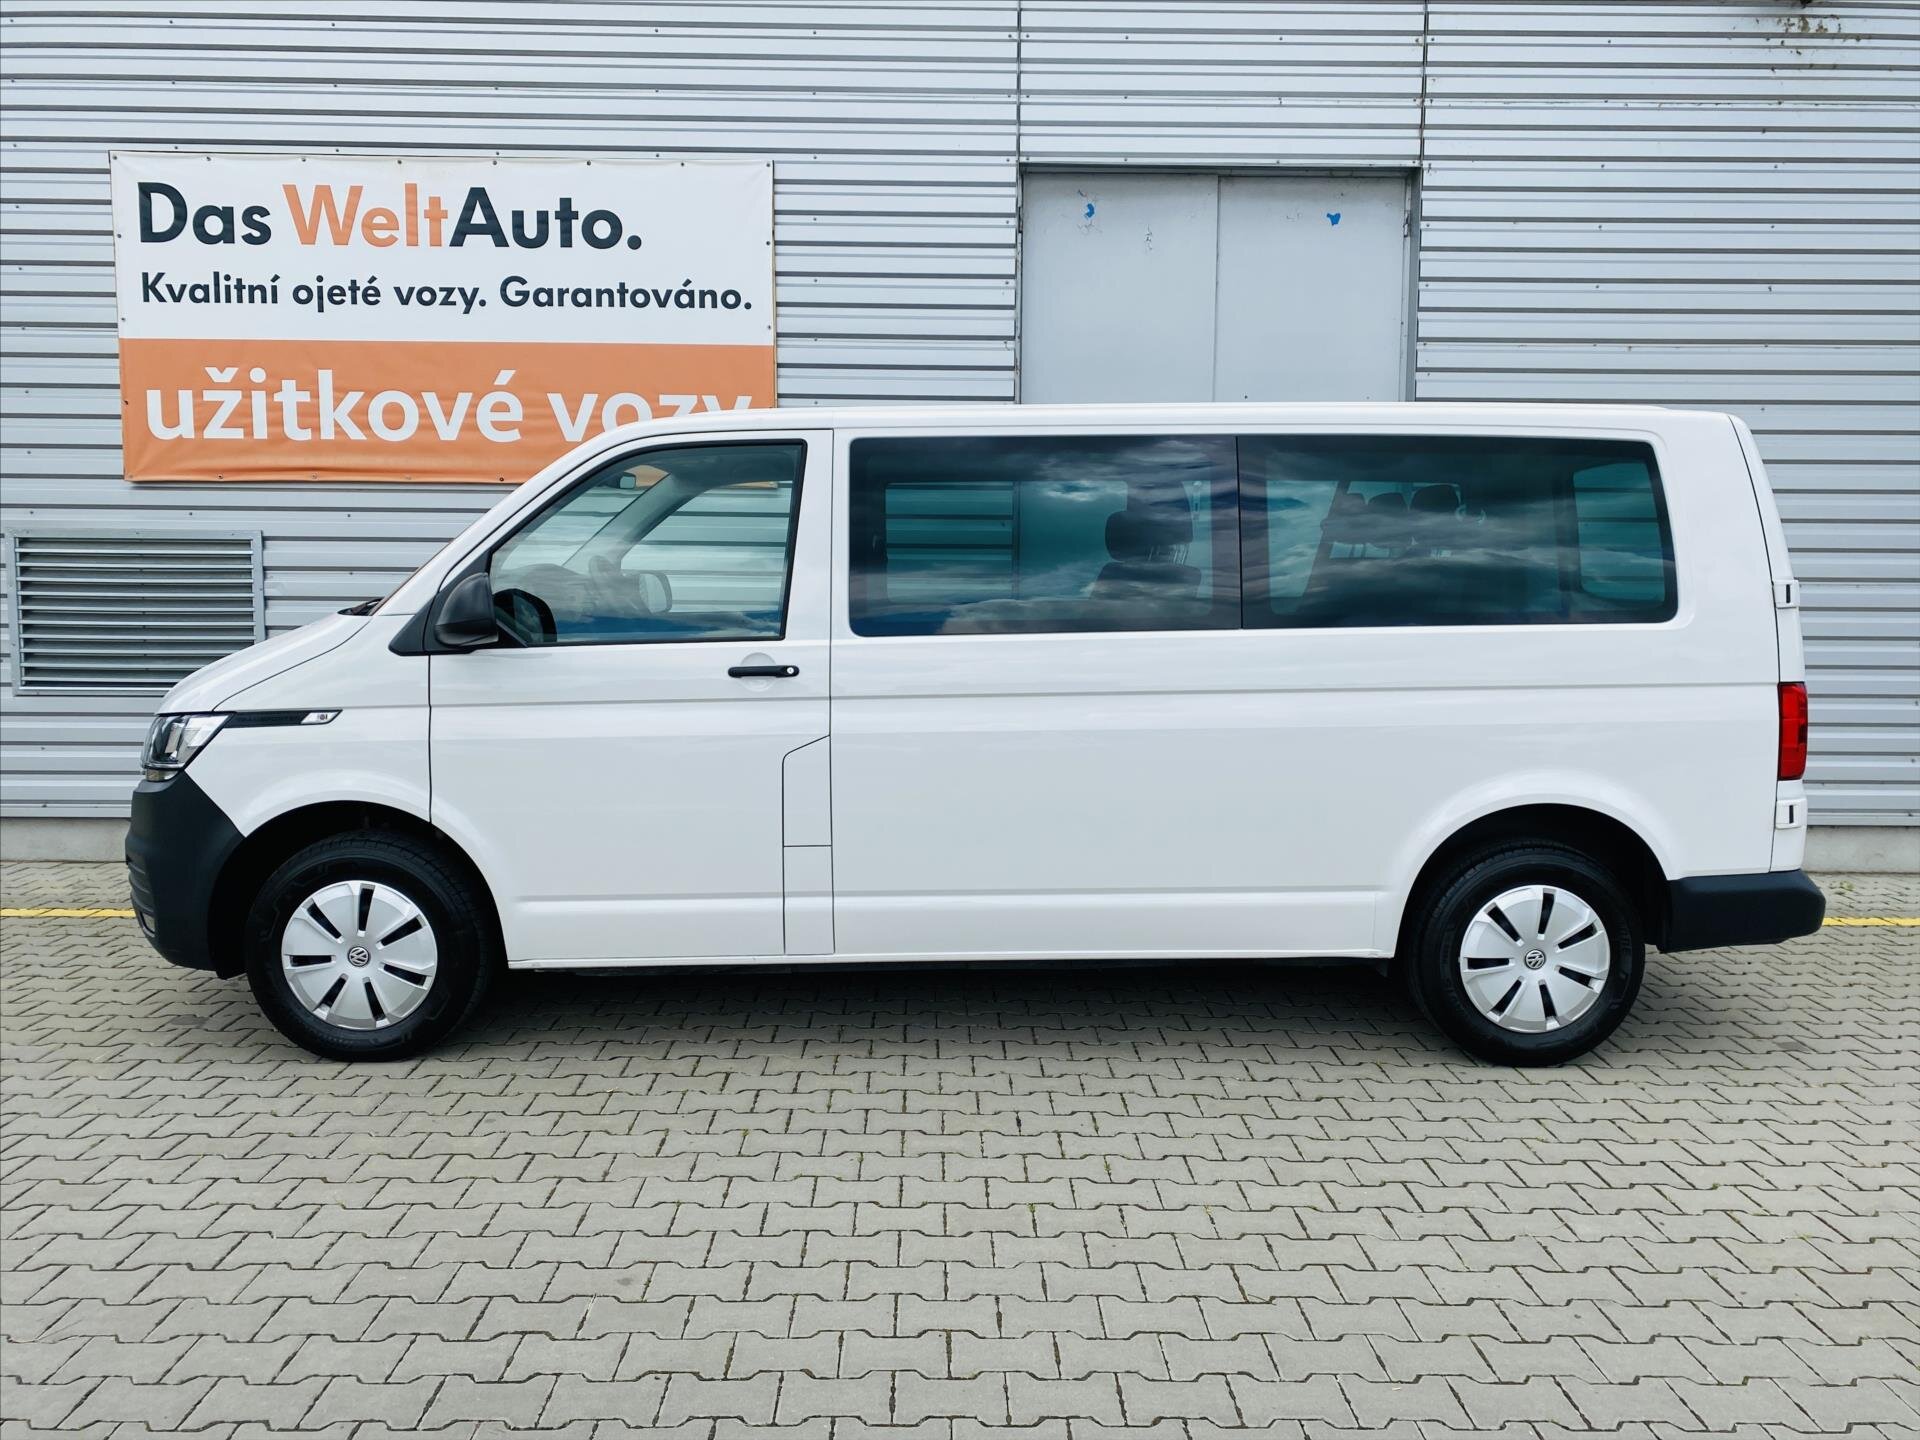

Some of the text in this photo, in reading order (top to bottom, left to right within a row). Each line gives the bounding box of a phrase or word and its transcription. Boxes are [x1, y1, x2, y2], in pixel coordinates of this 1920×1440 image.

[138, 181, 642, 250] Das WeltAuto.
[141, 272, 753, 315] Kvalitní ojeté vozy. Garantováno.
[146, 366, 753, 444] užitkové vo
